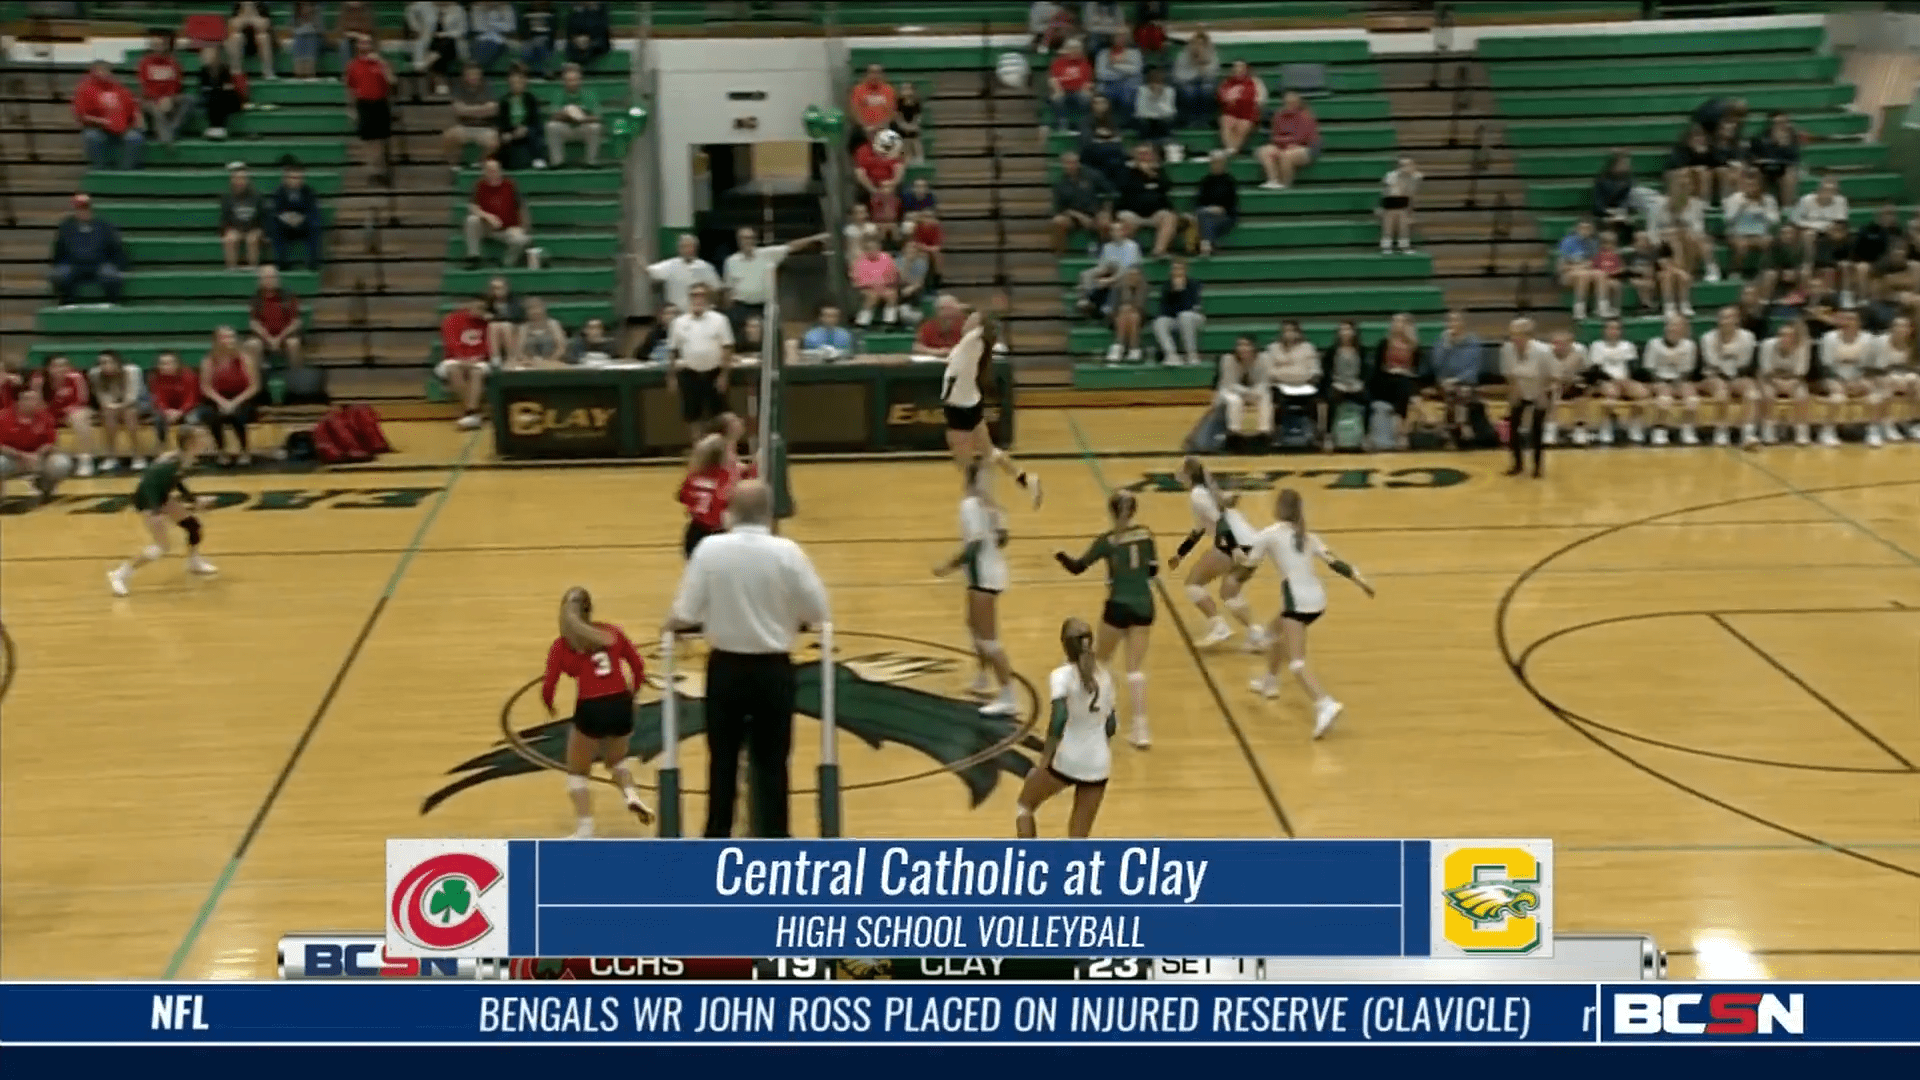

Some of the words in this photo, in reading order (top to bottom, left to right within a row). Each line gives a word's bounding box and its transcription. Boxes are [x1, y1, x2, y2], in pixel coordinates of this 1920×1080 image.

[1129, 544, 1140, 570] 1
[591, 651, 612, 676] 3
[1088, 686, 1101, 713] 2
